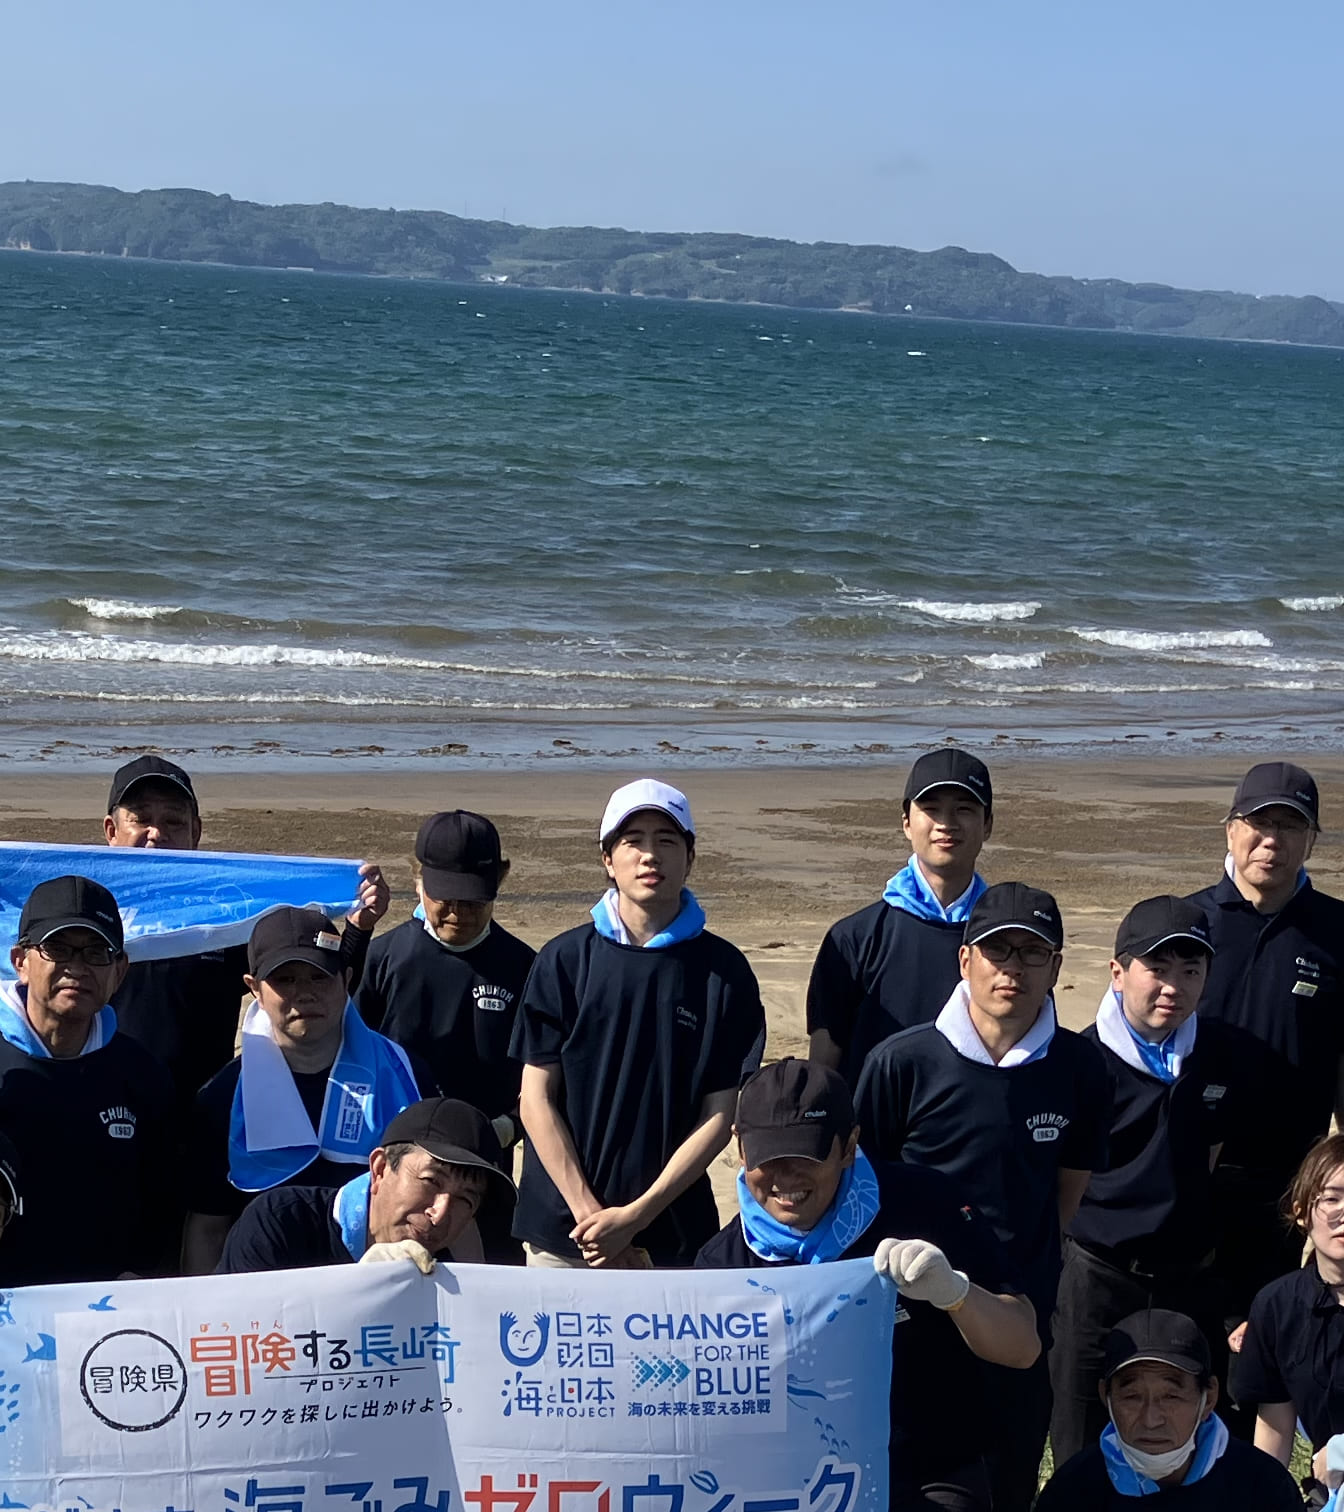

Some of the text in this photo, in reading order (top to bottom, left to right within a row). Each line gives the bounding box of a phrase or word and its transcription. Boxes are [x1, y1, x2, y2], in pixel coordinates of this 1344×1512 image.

[556, 1311, 614, 1339] 日本
[623, 1311, 770, 1341] CHANGE
[190, 1322, 462, 1397] 冒険する長崎
[694, 1343, 771, 1362] FOR THE
[89, 1365, 179, 1395] 冒険県
[298, 1374, 402, 1393] プロジェクト
[694, 1366, 772, 1398] BLUE
[194, 1395, 463, 1430] ワクワクを探しに出かけよう。
[546, 1406, 616, 1418] PROJECT
[626, 1399, 772, 1418] 海の未来を変える挑戦
